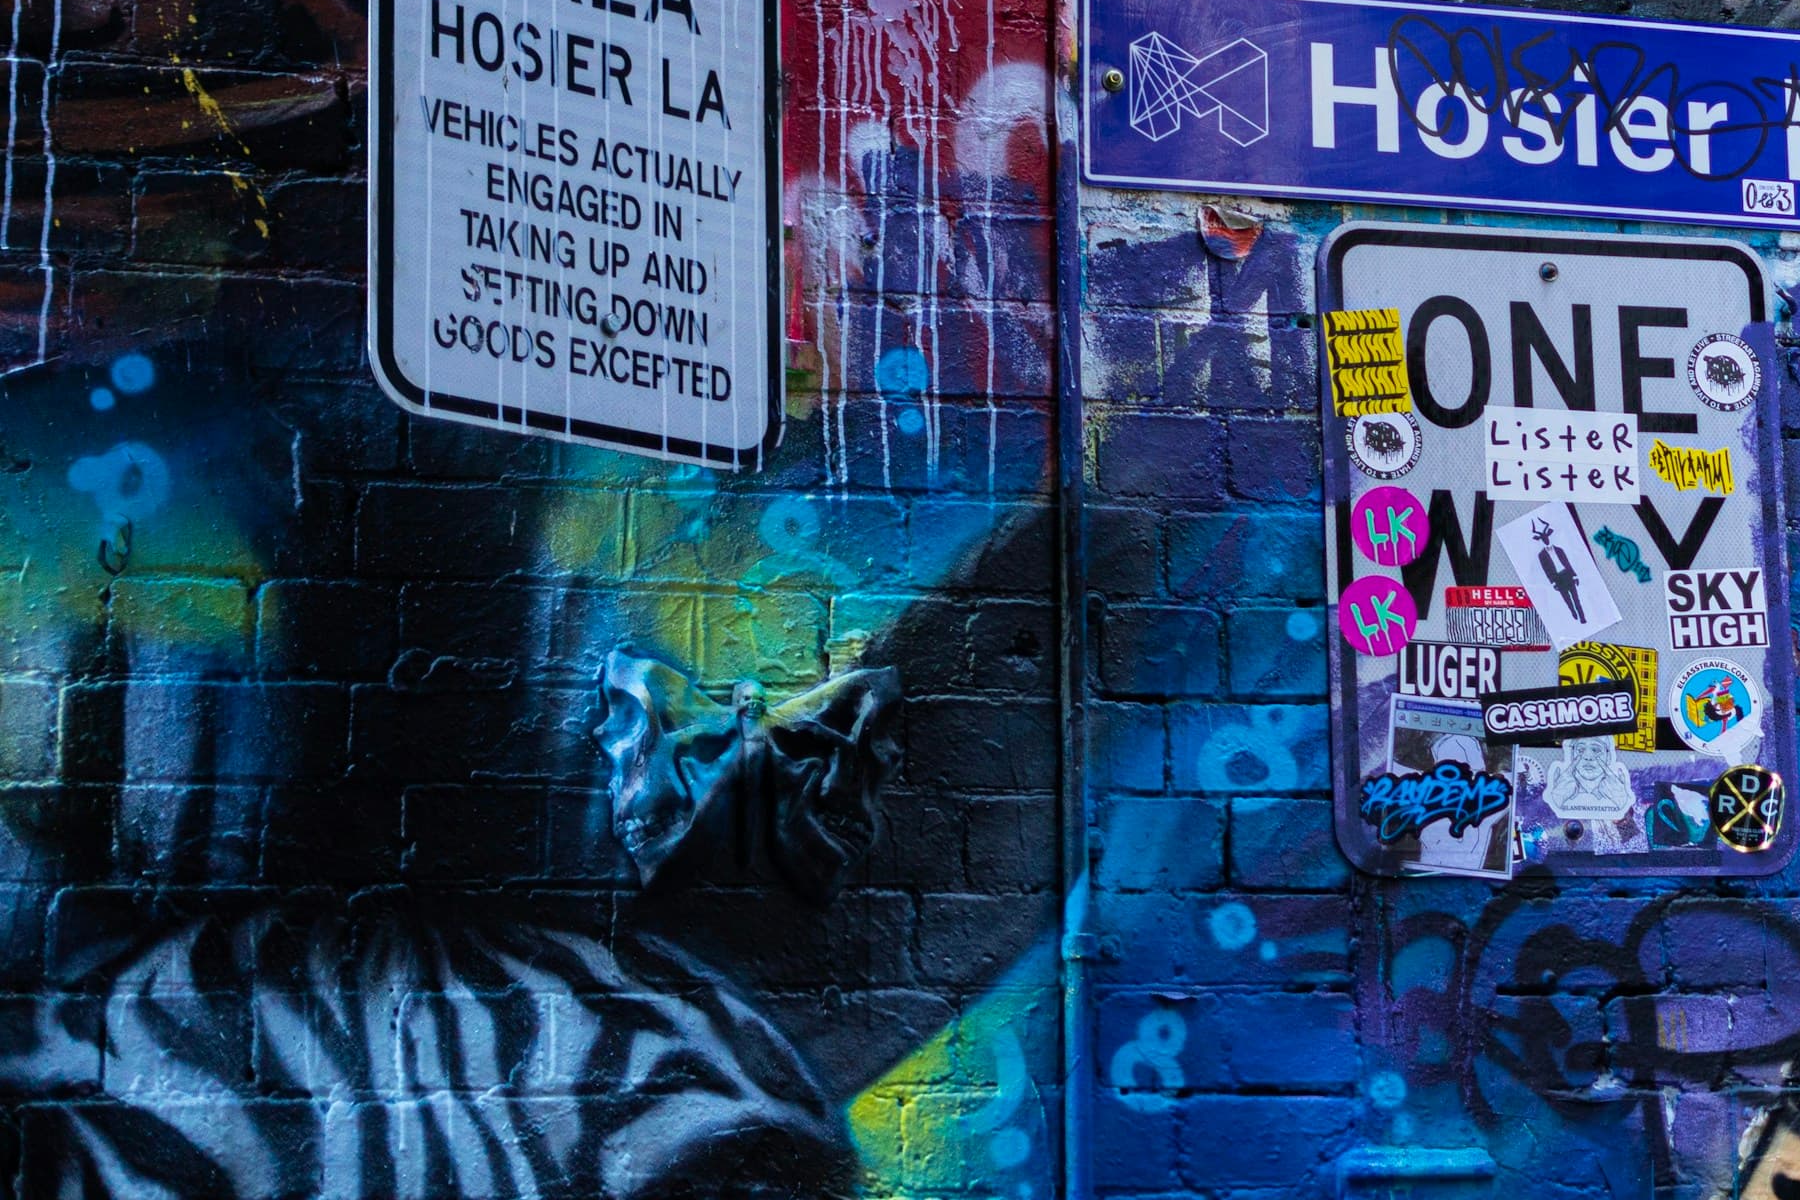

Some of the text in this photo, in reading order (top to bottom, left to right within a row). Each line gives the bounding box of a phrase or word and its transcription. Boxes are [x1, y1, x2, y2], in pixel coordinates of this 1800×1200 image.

[662, 57, 732, 131] LA
[1310, 41, 1728, 175] Hosier
[420, 95, 743, 202] VEHICLES ACTUALLY
[487, 163, 683, 242] ENGAGED IN
[460, 209, 708, 297] TAKING UP AND
[461, 263, 709, 348] SETTING DOWN
[434, 313, 732, 402] GOODS EXCEPTED
[1406, 295, 1699, 434] ONE
[1365, 506, 1417, 550] LK
[1399, 488, 1726, 621] WY
[1350, 590, 1406, 642] LK
[1472, 589, 1526, 600] HELLO
[1667, 571, 1760, 612] SKY
[1672, 614, 1766, 648] HIGH
[1400, 644, 1497, 698] LUGER
[1677, 661, 1749, 689] ELSASSTRAVEL.COM
[1486, 693, 1634, 733] CASHMORE
